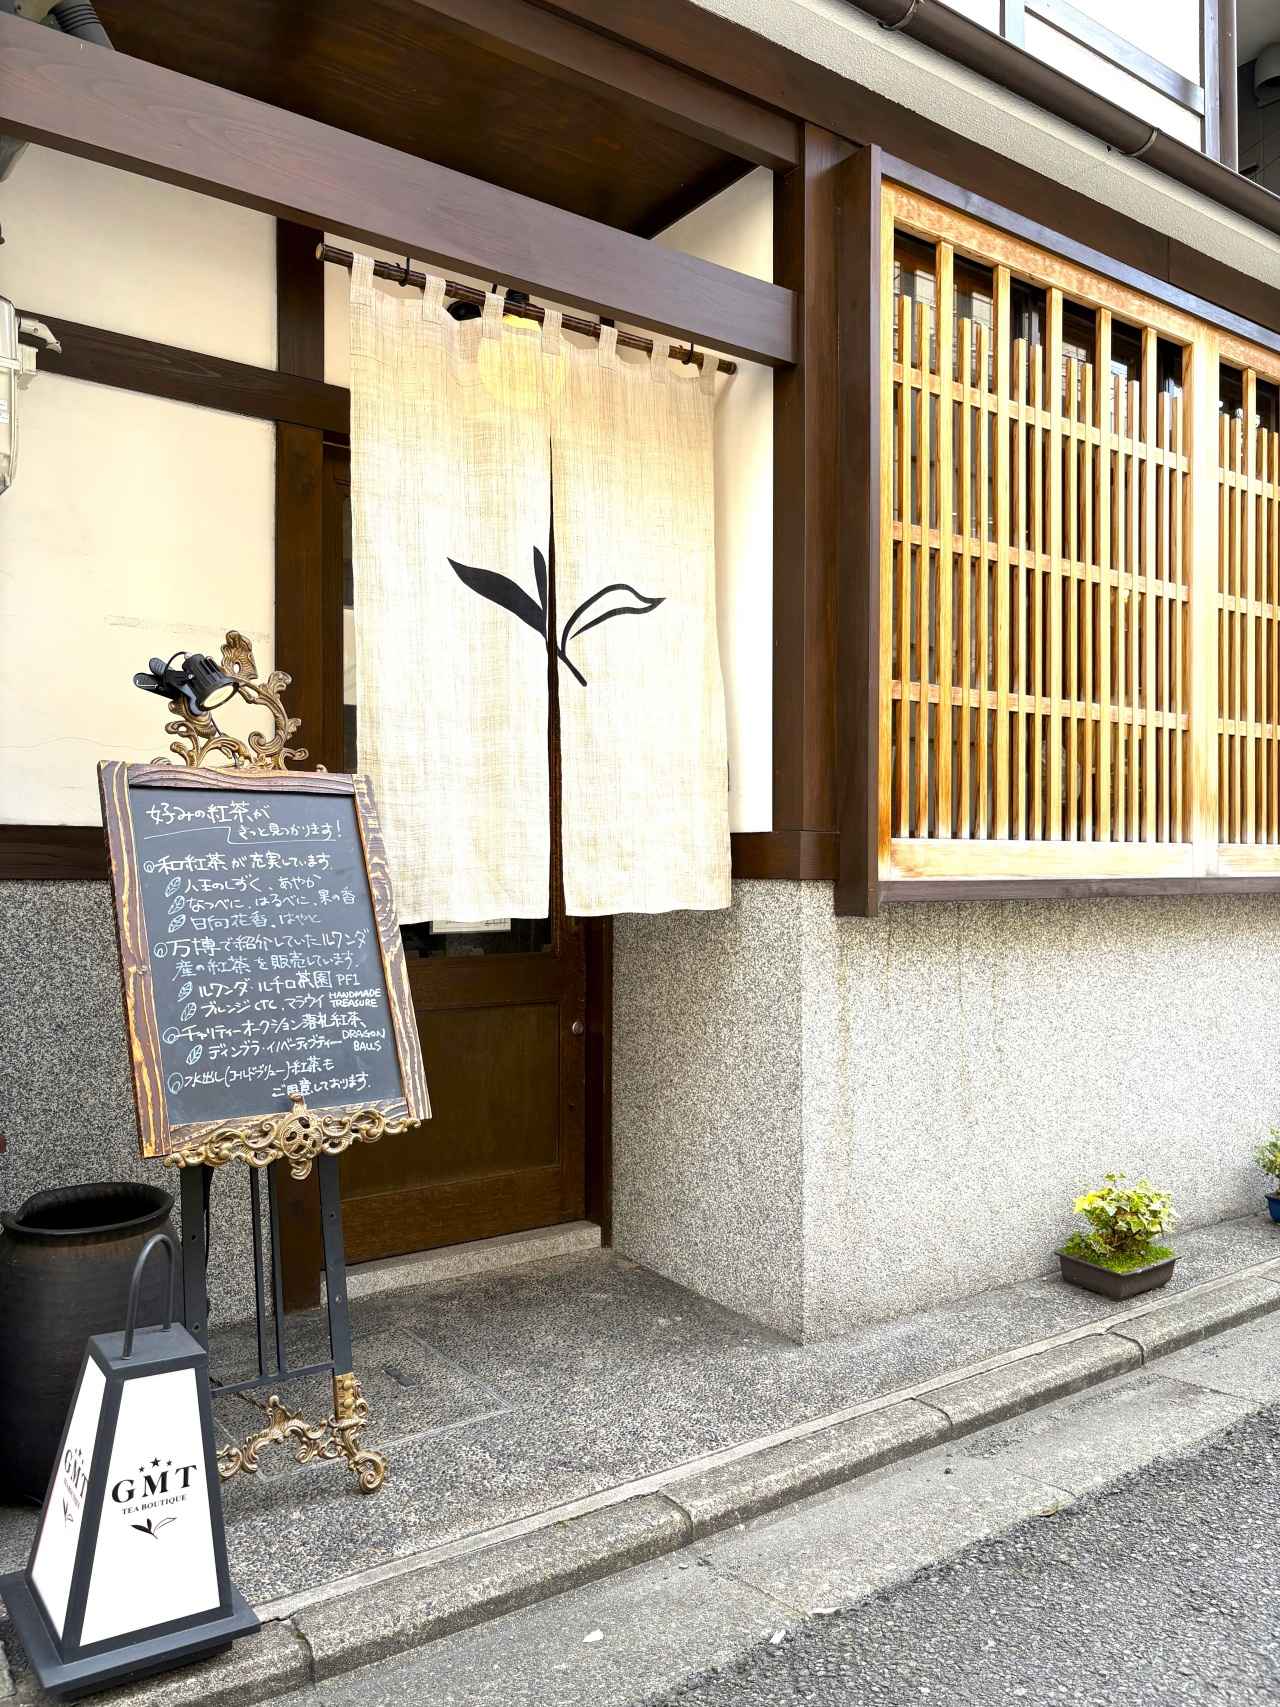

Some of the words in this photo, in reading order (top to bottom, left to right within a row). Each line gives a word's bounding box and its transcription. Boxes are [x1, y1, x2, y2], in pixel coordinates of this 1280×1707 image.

[146, 800, 271, 825] 好みの紅茶が
[328, 988, 382, 999] HANDMADE
[329, 998, 378, 1008] TREASURE
[342, 1028, 386, 1040] DRAGON
[353, 1040, 383, 1053] BALLS
[112, 1465, 197, 1503] GMT
[122, 1506, 140, 1515] TEA
[141, 1494, 187, 1511] BOUTIQUE
